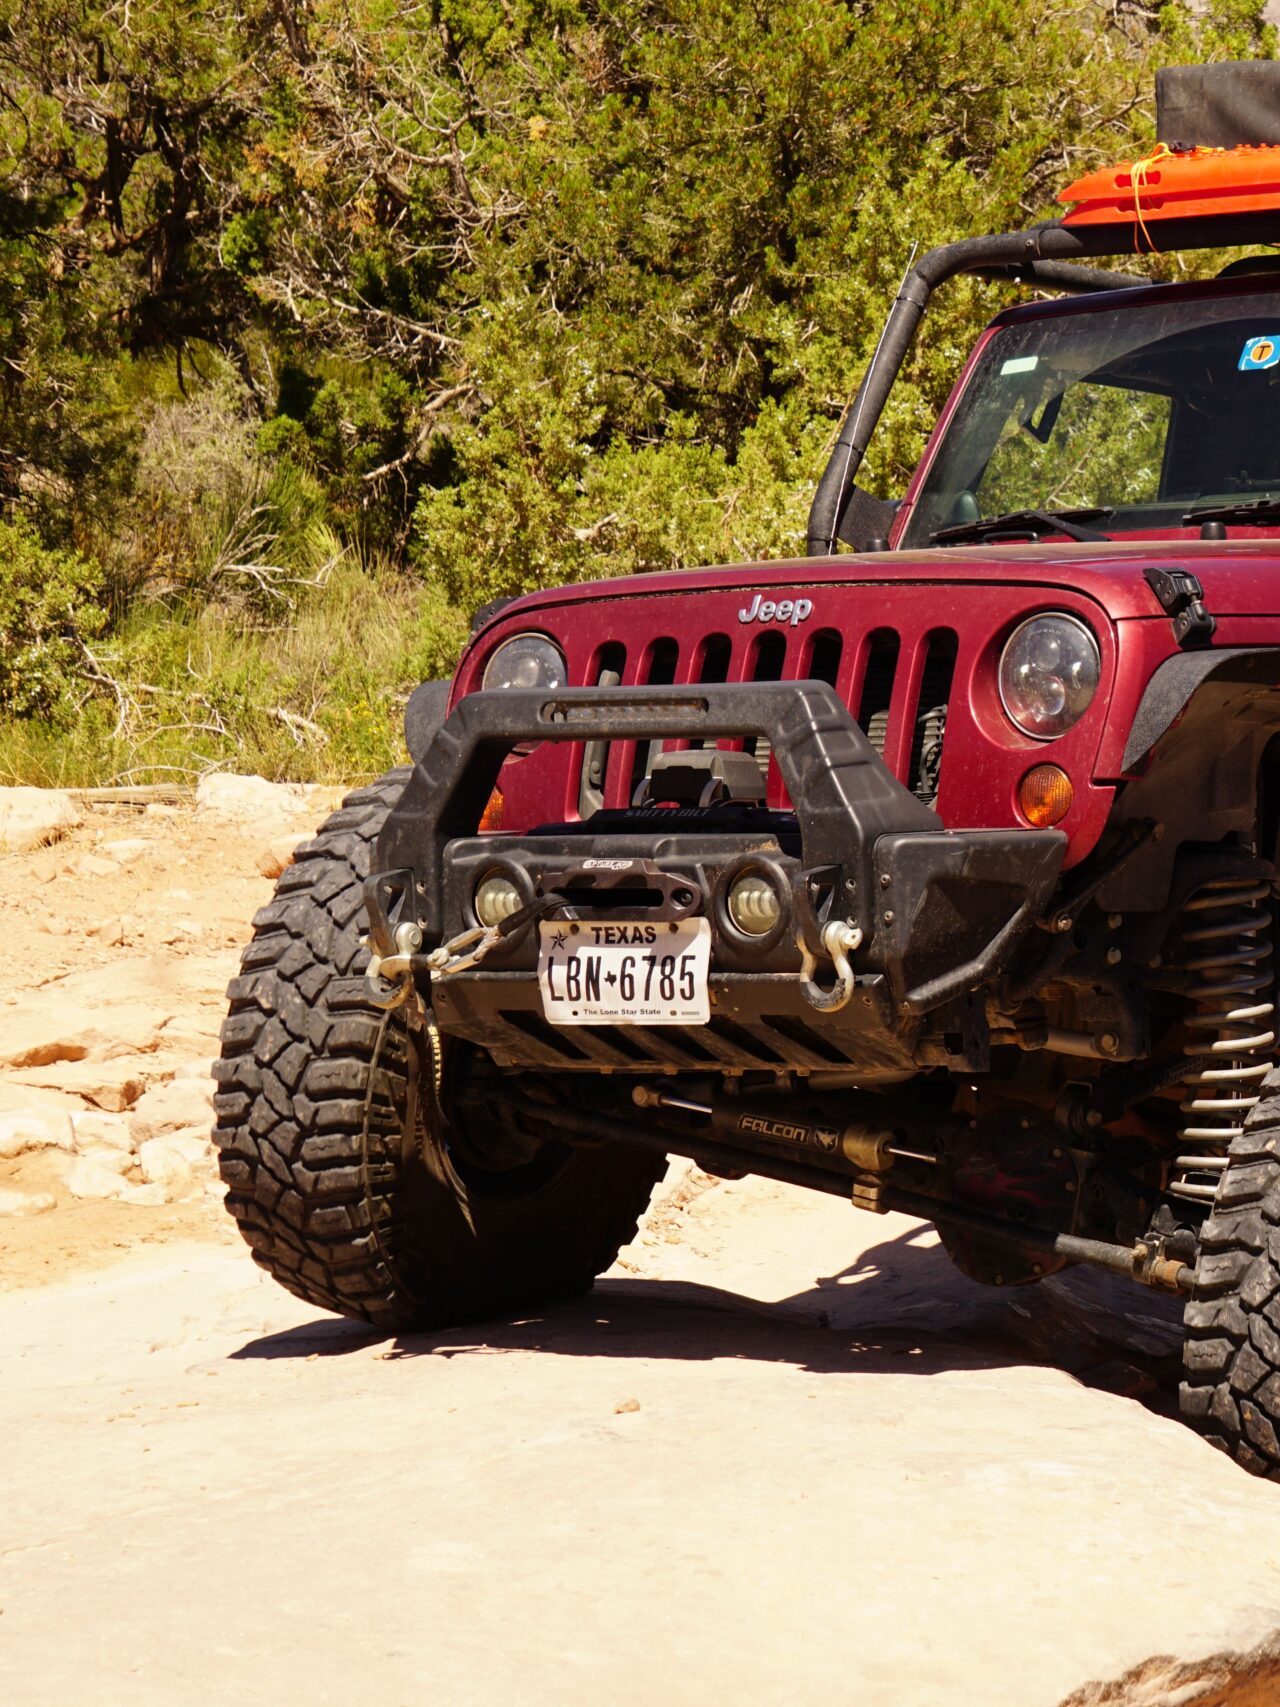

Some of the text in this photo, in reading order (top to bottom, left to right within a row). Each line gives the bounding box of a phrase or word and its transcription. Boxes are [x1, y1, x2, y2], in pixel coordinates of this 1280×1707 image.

[1259, 345, 1271, 361] T
[738, 594, 813, 627] Jeep
[623, 808, 712, 818] SMITTYBILT
[591, 926, 657, 945] TEXAS
[741, 1116, 806, 1142] FALCON
